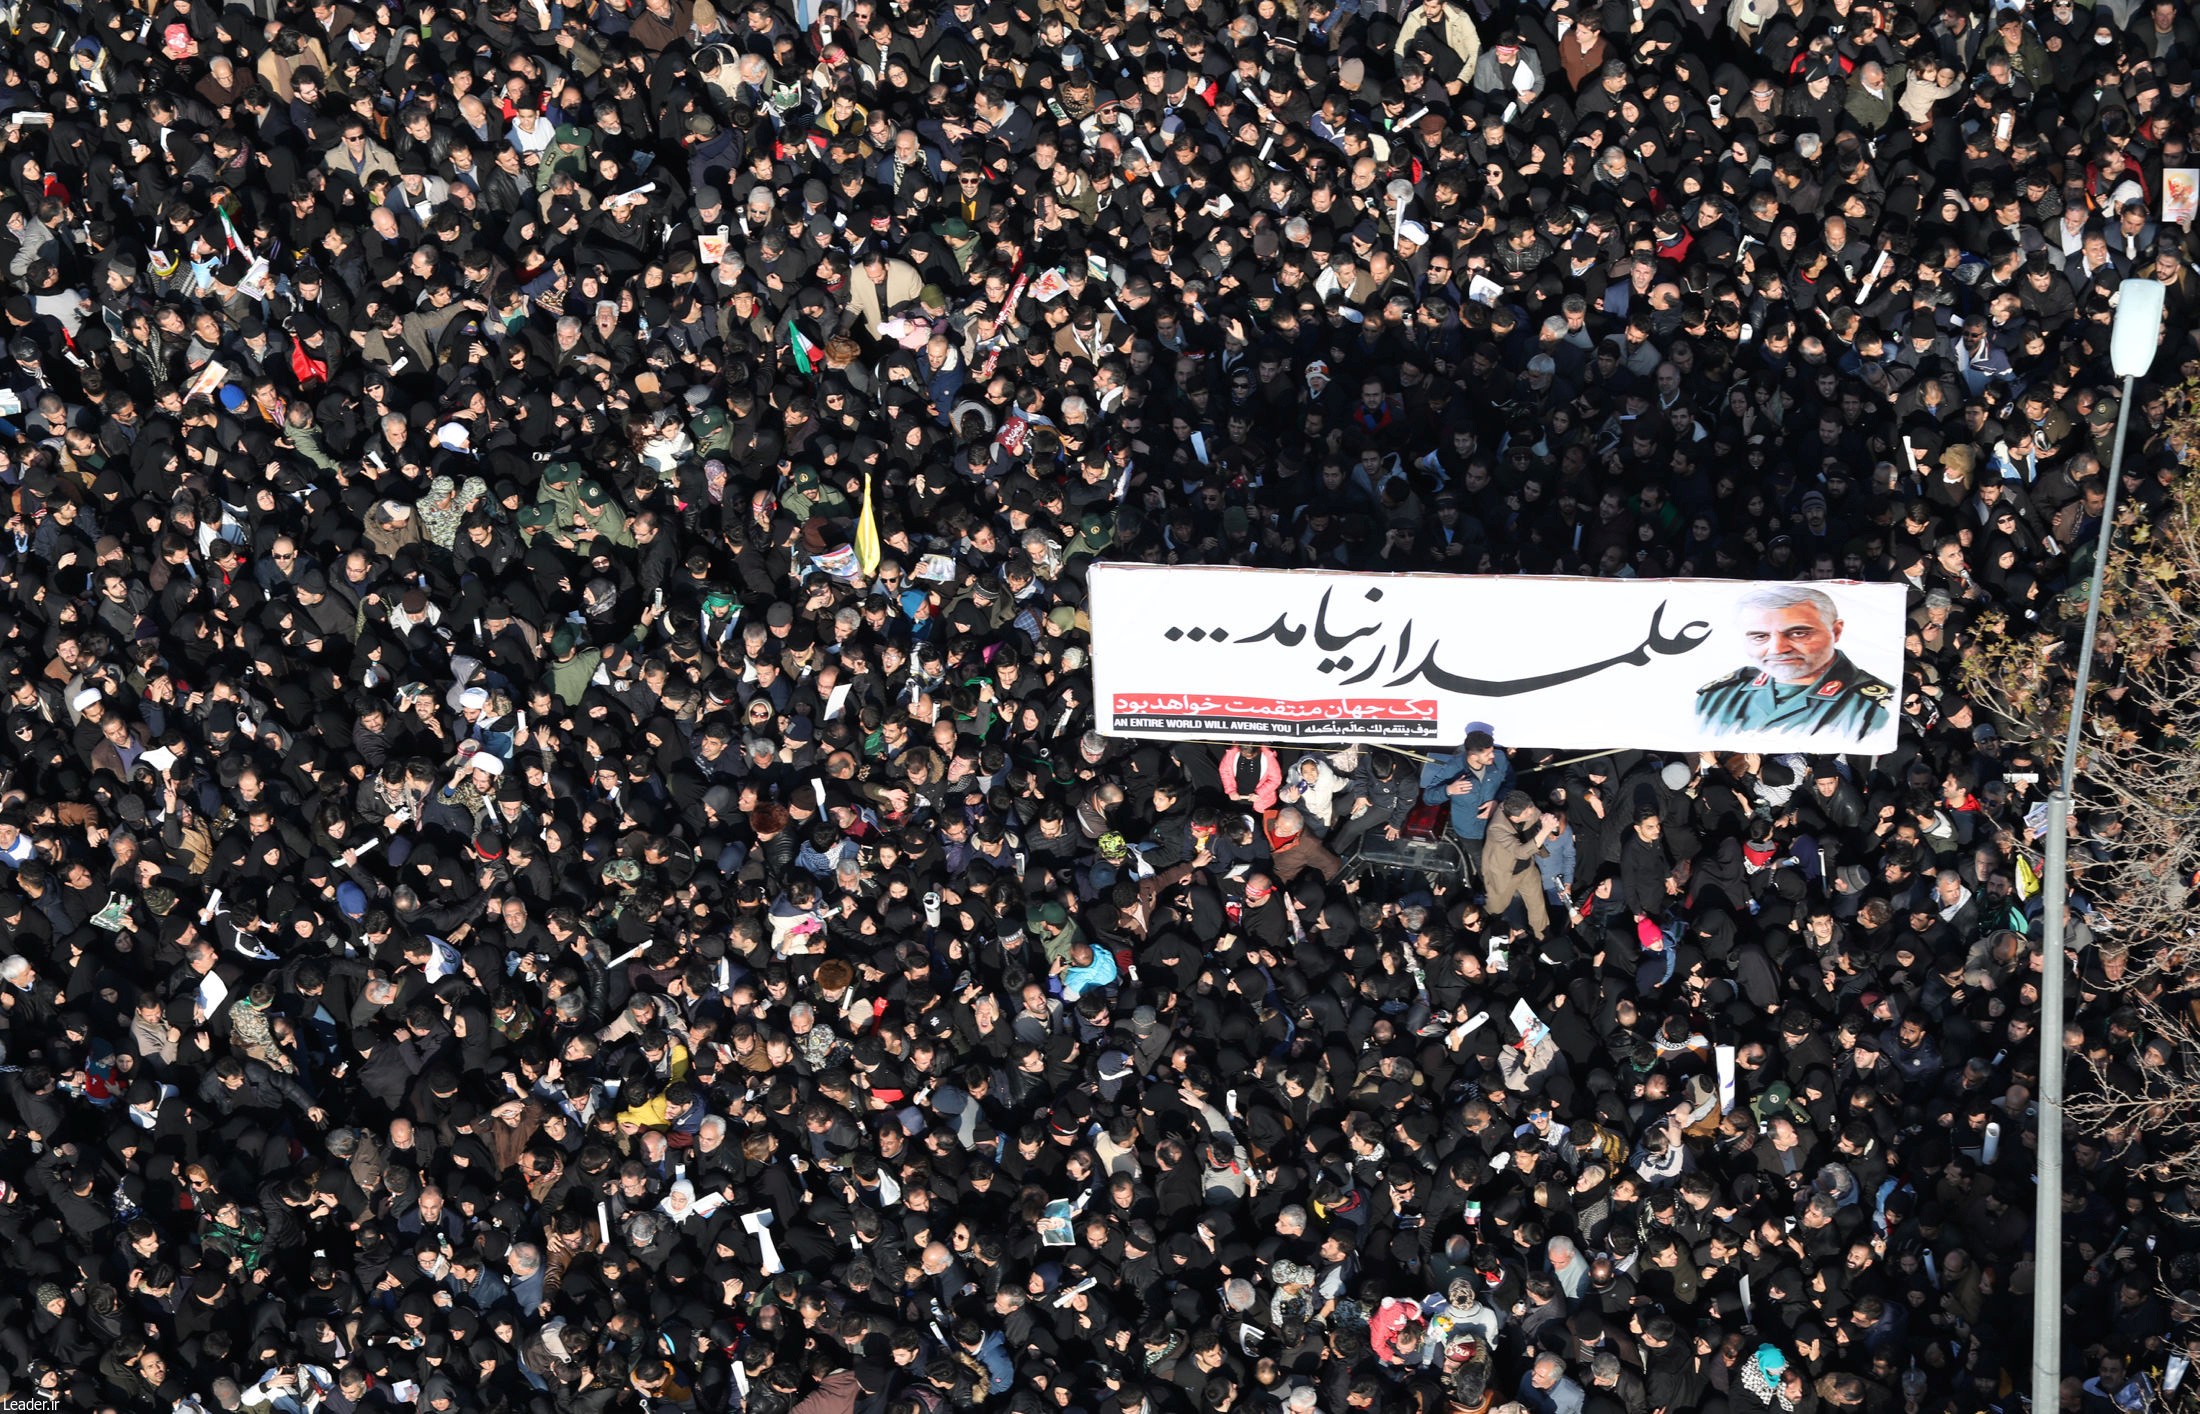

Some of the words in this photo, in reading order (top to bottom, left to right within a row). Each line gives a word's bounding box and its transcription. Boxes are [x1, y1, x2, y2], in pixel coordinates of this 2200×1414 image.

[1339, 599, 1713, 698] علمدار
[1115, 698, 1149, 715] بود
[1149, 694, 1222, 715] خواهد
[1224, 699, 1322, 718] منتقمت
[1324, 698, 1386, 720] جهان
[1388, 699, 1434, 721] یک
[1113, 718, 1129, 728] AN
[1130, 718, 1165, 729] ENTIRE
[1166, 719, 1203, 730] WORLD
[1204, 720, 1229, 730] WILL
[1230, 721, 1269, 732] AVENGE
[1270, 723, 1292, 734] YOU
[1304, 720, 1341, 734] بأكمله
[1367, 723, 1383, 734] لك
[1410, 723, 1438, 736] سوف
